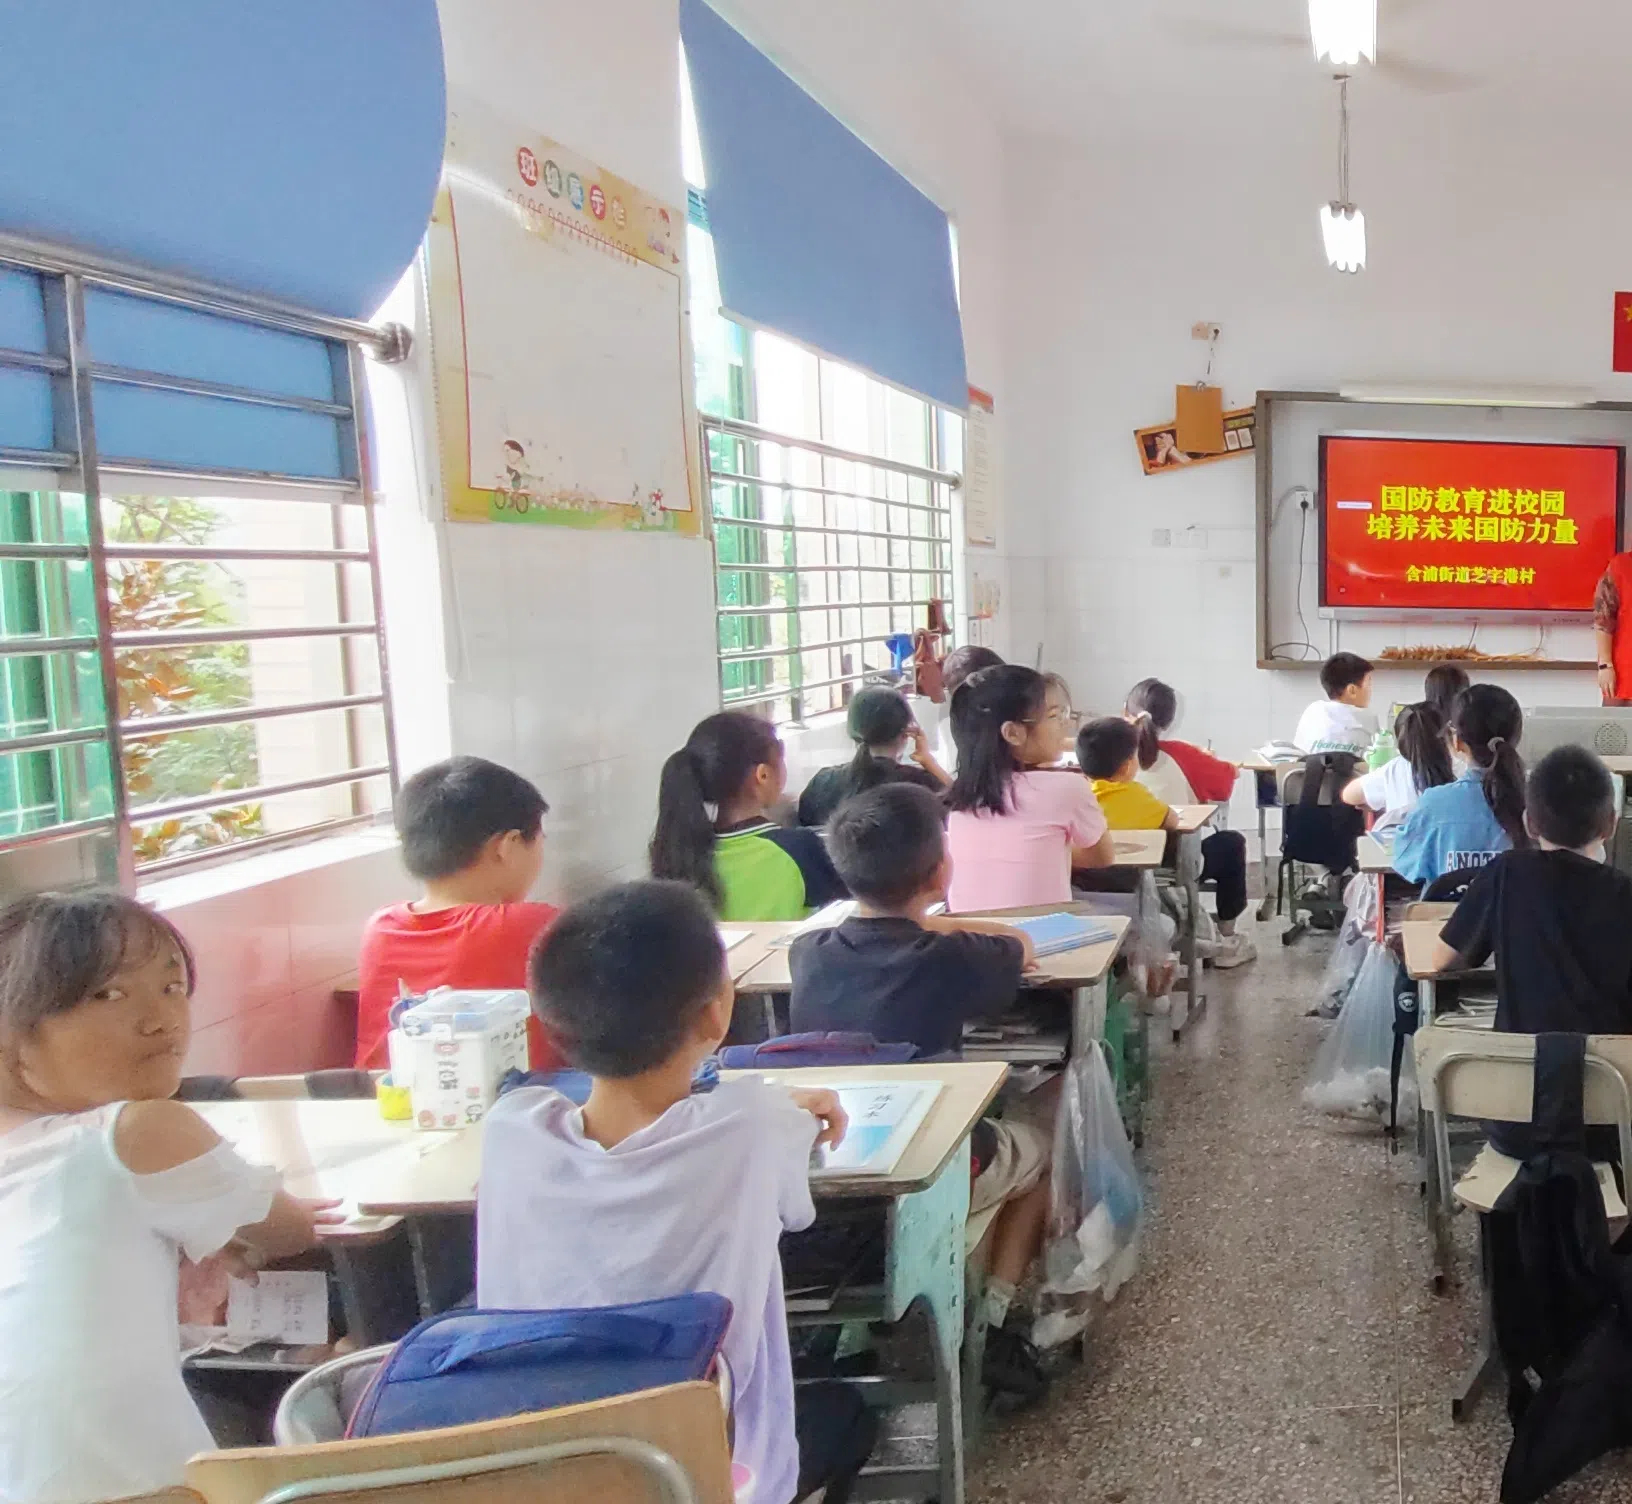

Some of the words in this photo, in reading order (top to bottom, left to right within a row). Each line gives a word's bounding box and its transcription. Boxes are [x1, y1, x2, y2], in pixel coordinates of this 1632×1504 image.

[1381, 485, 1566, 517] 国防教育进校园
[1366, 513, 1580, 545] 培养未来国防力量
[1447, 850, 1503, 872] ANOT
